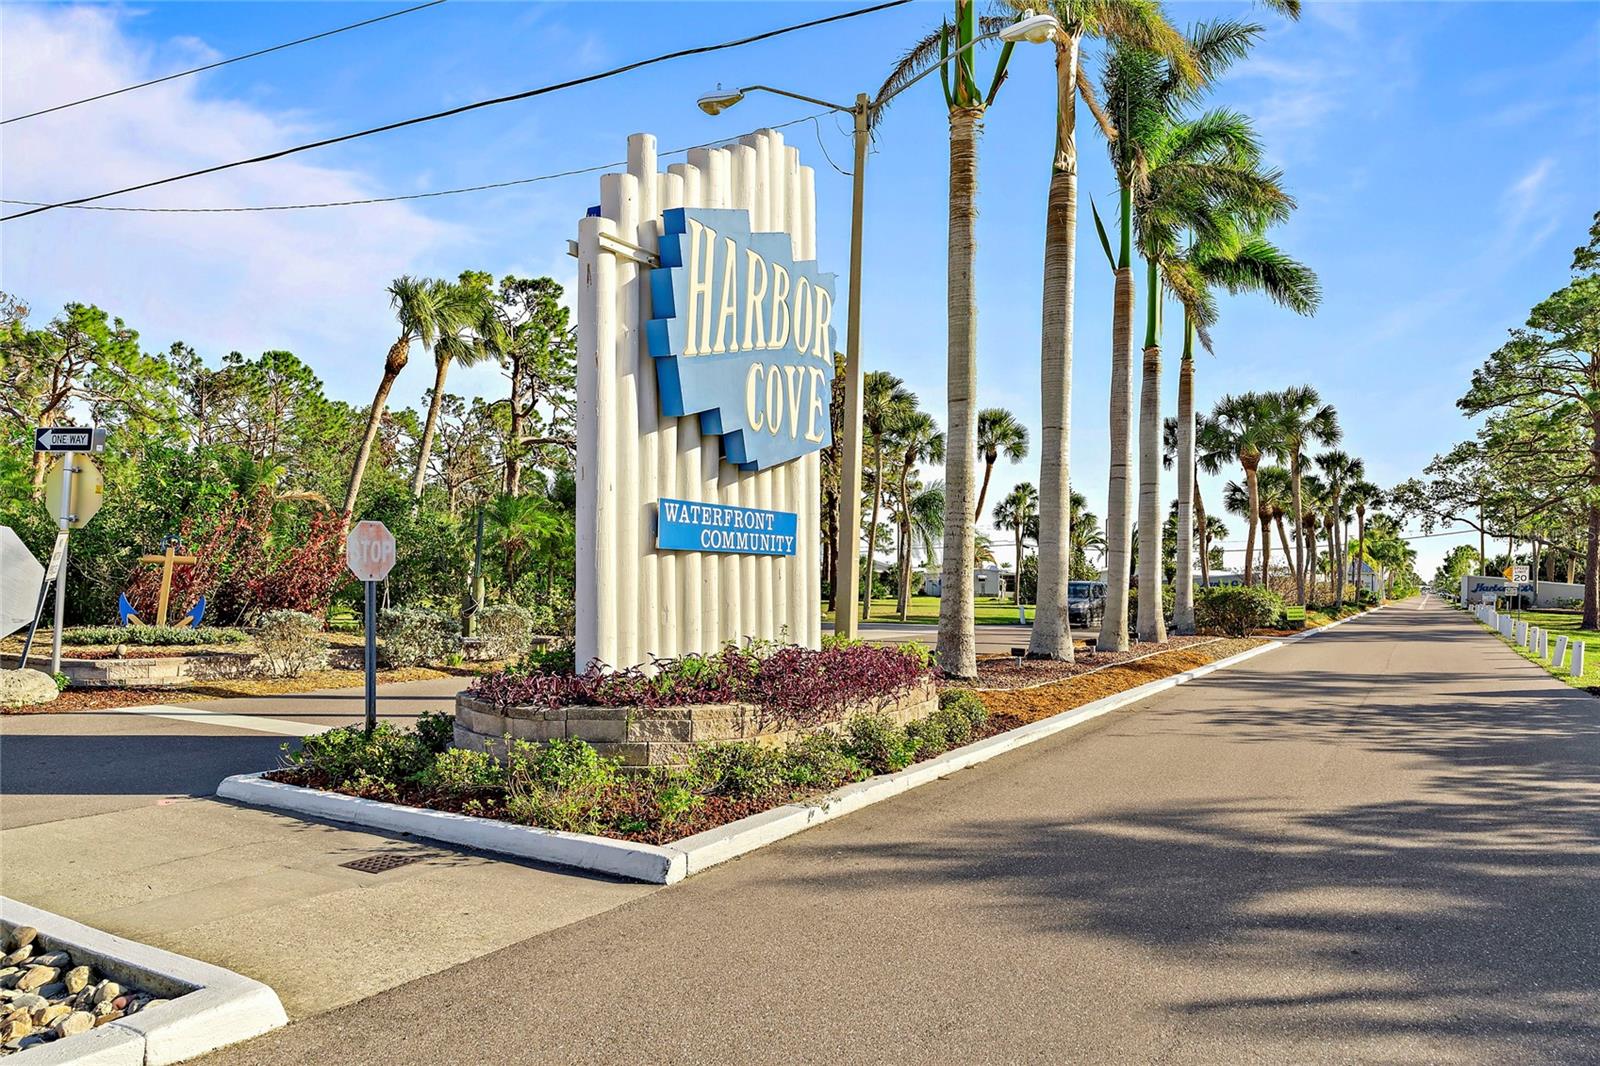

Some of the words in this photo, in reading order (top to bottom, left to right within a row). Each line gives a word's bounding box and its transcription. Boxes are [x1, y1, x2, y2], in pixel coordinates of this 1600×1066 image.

[683, 218, 833, 368] HARBOR
[746, 362, 826, 443] COVE
[51, 434, 67, 444] ONE
[70, 434, 86, 444] WAY
[664, 502, 775, 531] WATERFRONT
[352, 540, 393, 562] STOP
[700, 529, 794, 553] COMMUNITY
[1514, 574, 1528, 582] 20
